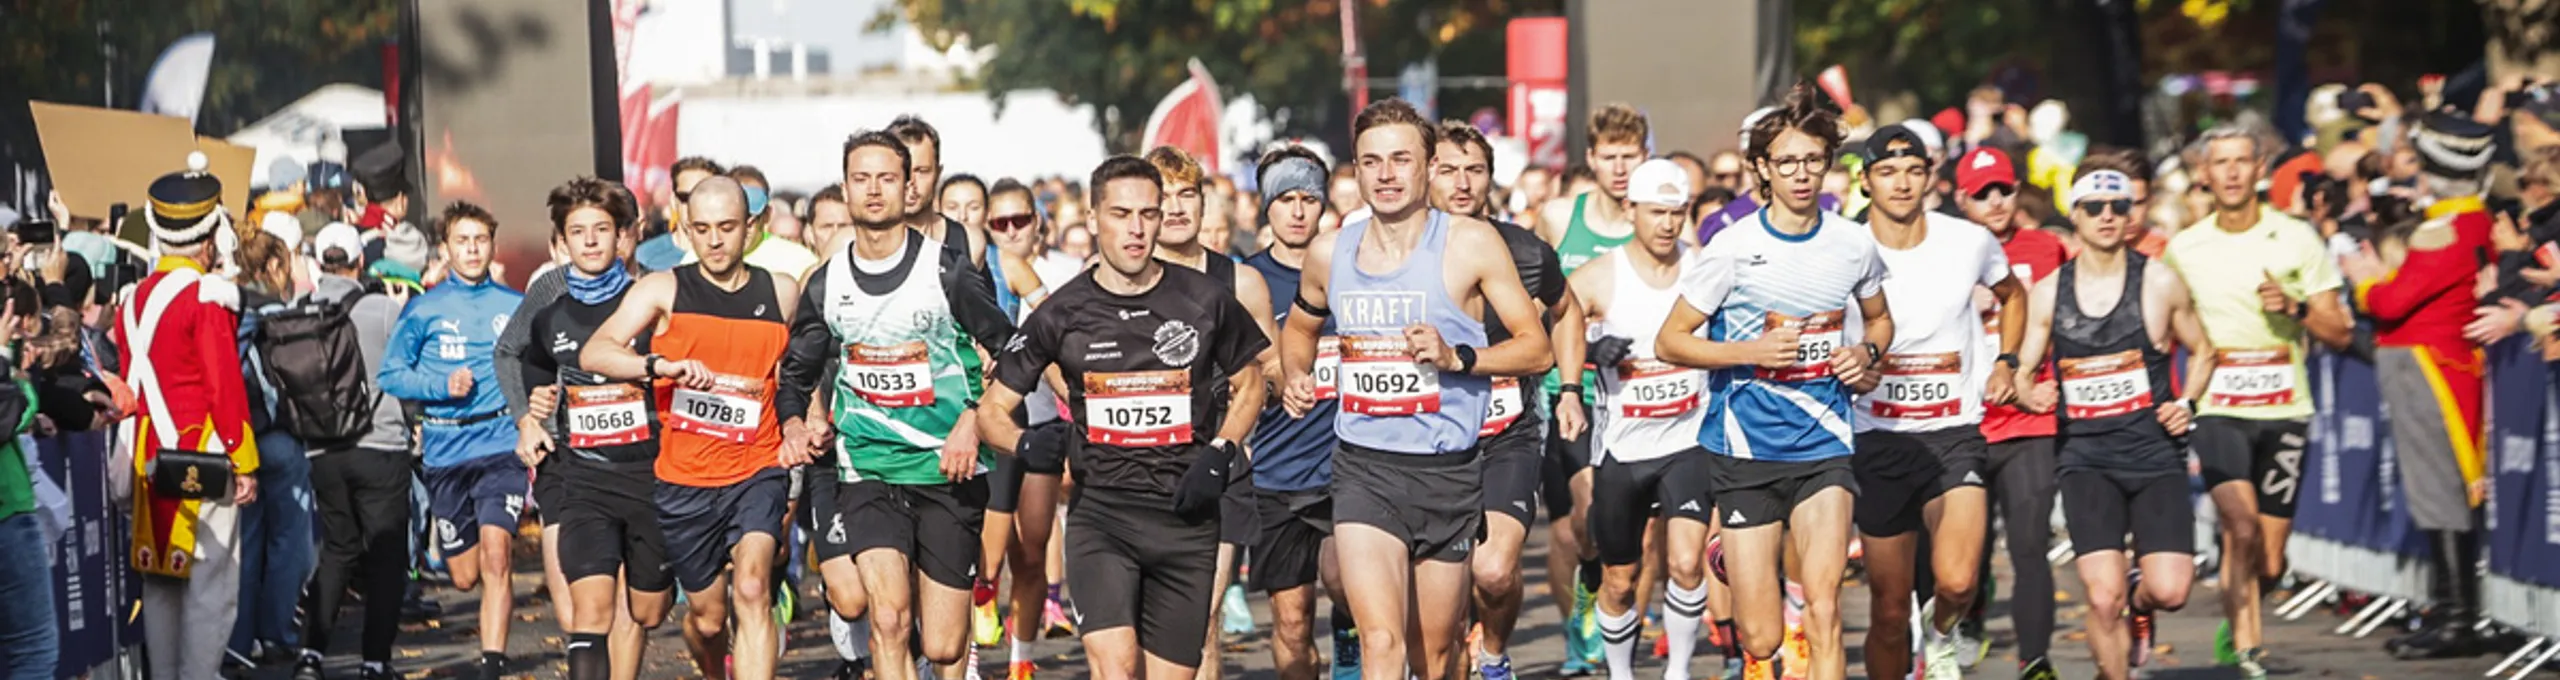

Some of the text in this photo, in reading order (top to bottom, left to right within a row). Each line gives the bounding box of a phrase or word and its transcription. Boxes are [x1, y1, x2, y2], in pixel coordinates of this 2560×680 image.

[1342, 296, 1419, 326] KRAFT.
[1797, 340, 1831, 362] 669
[858, 372, 917, 391] 10533
[1353, 372, 1420, 393] 10692
[1632, 378, 1689, 401] 10525
[1885, 382, 1949, 401] 10560
[2075, 379, 2135, 402] 10538
[577, 410, 635, 431] 10668
[686, 398, 746, 425] 10788
[1105, 406, 1172, 427] 10752
